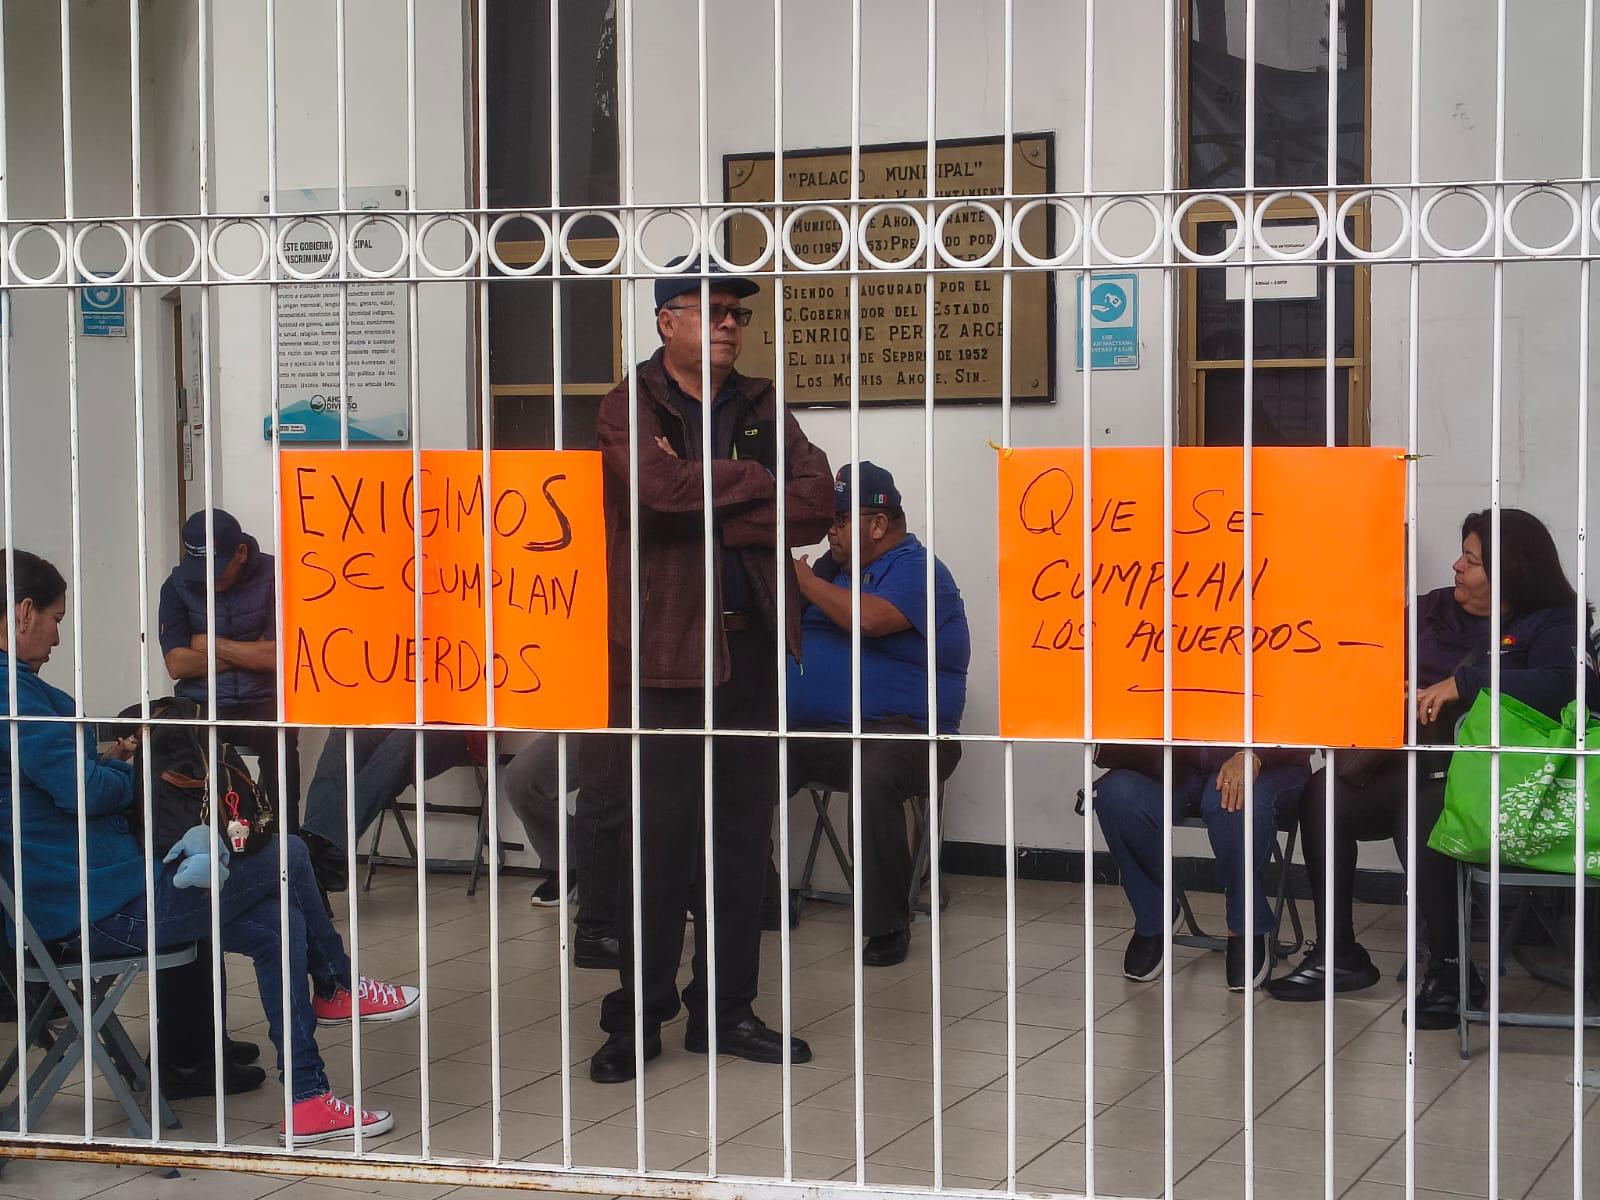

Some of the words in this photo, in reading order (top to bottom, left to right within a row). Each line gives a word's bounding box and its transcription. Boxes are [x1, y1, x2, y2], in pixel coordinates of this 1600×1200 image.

[788, 169, 866, 187] "PALACO
[886, 160, 983, 181] MUNIIPAL"
[969, 234, 993, 246] POR
[783, 285, 835, 300] SIENDO
[940, 281, 965, 293] POR
[974, 280, 991, 292] EL
[895, 305, 918, 318] DEL
[934, 301, 990, 317] ESTADO
[888, 323, 949, 342] PERZ
[788, 352, 807, 366] EL
[815, 352, 835, 365] DIA
[860, 352, 875, 364] DE
[937, 349, 952, 361] DE
[959, 348, 988, 361] 1952
[796, 374, 822, 388] LOS
[832, 373, 884, 388] MOHIS
[896, 371, 948, 385] AHOE,
[955, 368, 988, 384] SIN.
[297, 467, 572, 552] EXIGIMOS
[1020, 467, 1137, 535] QUE
[1173, 489, 1264, 535] SE
[302, 551, 385, 601] SE
[1031, 557, 1269, 612] CUMPLAN
[1030, 617, 1097, 651] LOS
[1125, 619, 1322, 662] ACUERDOS
[294, 627, 542, 694] ACUERDOS
